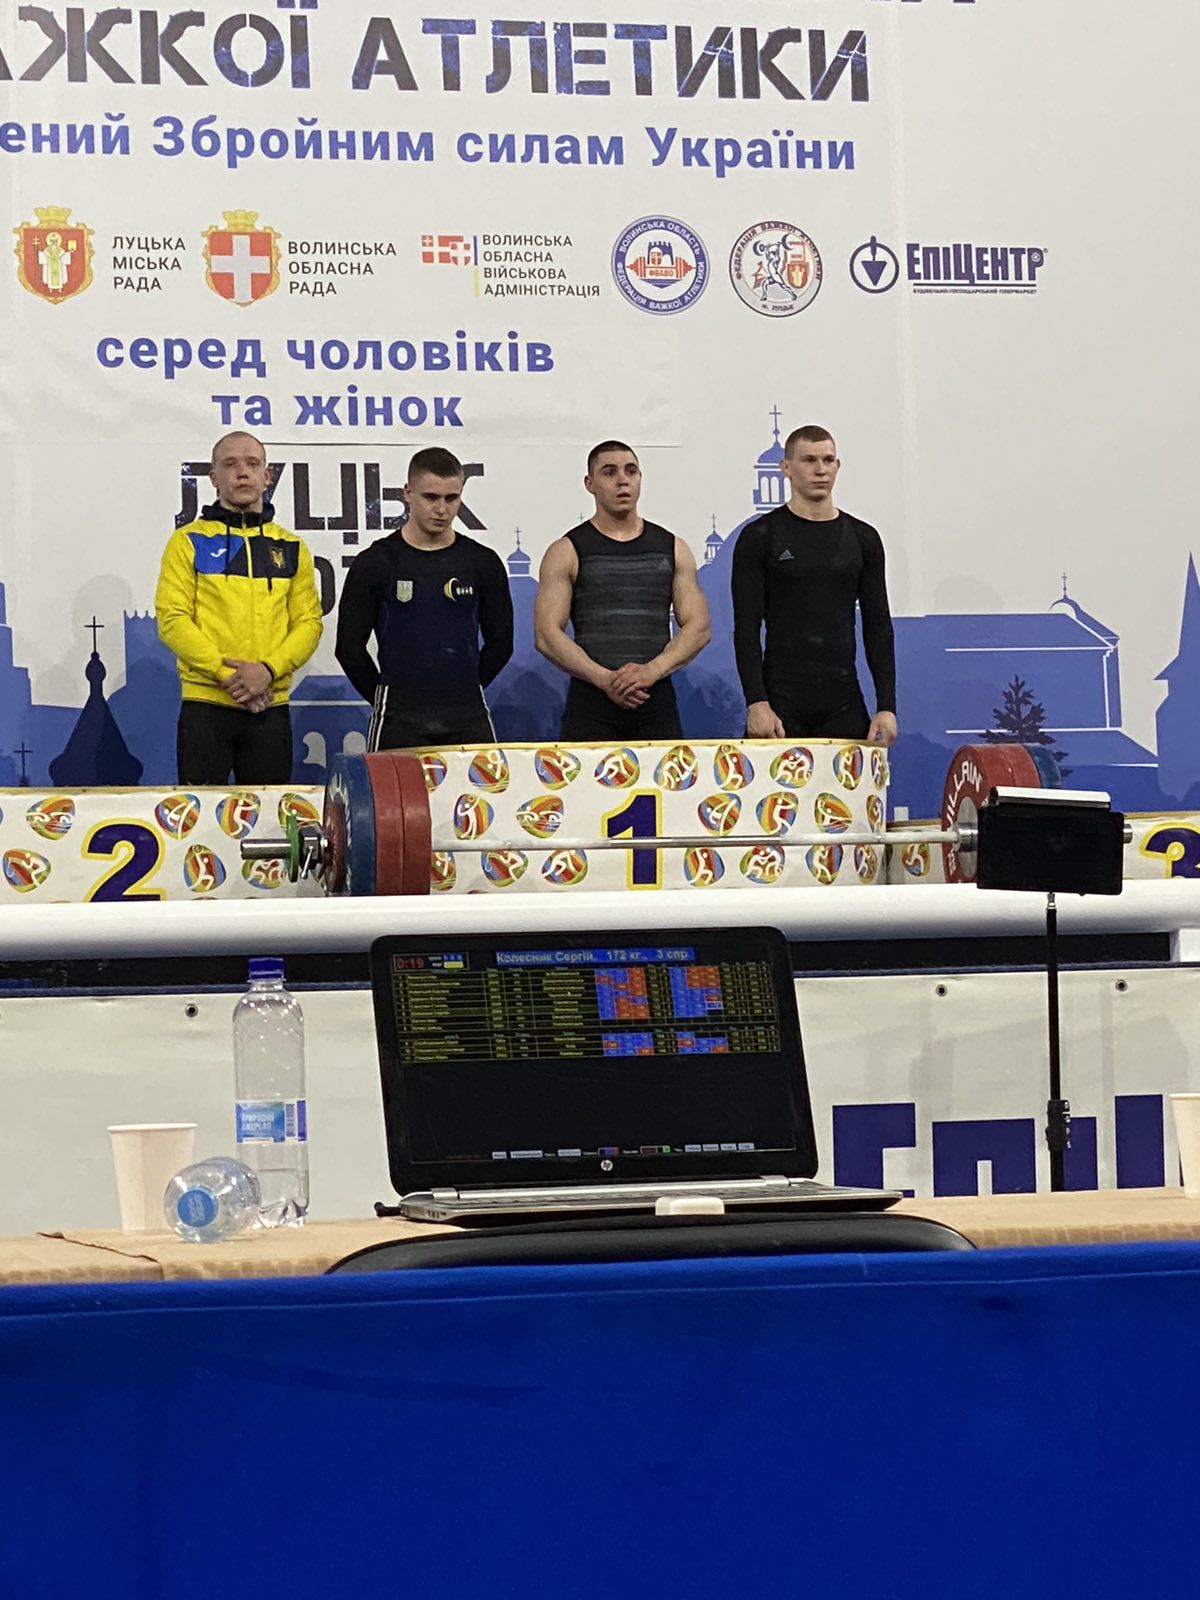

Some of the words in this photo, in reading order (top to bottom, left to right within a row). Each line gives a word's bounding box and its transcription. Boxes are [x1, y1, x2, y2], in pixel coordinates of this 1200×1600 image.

[0, 0, 318, 91] ЖКОЇ
[352, 17, 870, 102] АТЛЕТИКИ
[153, 114, 434, 168] Збройним
[456, 132, 624, 166] силам
[644, 126, 855, 178] України
[112, 236, 186, 252] ЛУЦЬКА
[482, 235, 573, 247] ВОЛИНСЬКА
[619, 221, 665, 253] ВОЛИНСЬКА
[667, 222, 700, 255] ОБЛАСТЬ
[288, 241, 397, 256] ВОЛИНСЬКА
[112, 257, 182, 271] МІСЬКА
[483, 251, 554, 263] ОБЛАСНА
[906, 243, 1045, 284] ЕПІЦЕНТР
[288, 261, 374, 276] ОБЛАСНА
[483, 267, 567, 280] ВІЙСЬКОВА
[113, 277, 162, 292] РАДА
[289, 281, 337, 297] РАДА
[484, 284, 600, 298] АДМІНІСТРАЦІЯ
[97, 336, 266, 379] серед
[287, 330, 555, 372] чоловіків
[212, 394, 272, 425] та
[295, 384, 464, 426] жінок
[84, 820, 165, 902] 2
[607, 951, 627, 960] 172
